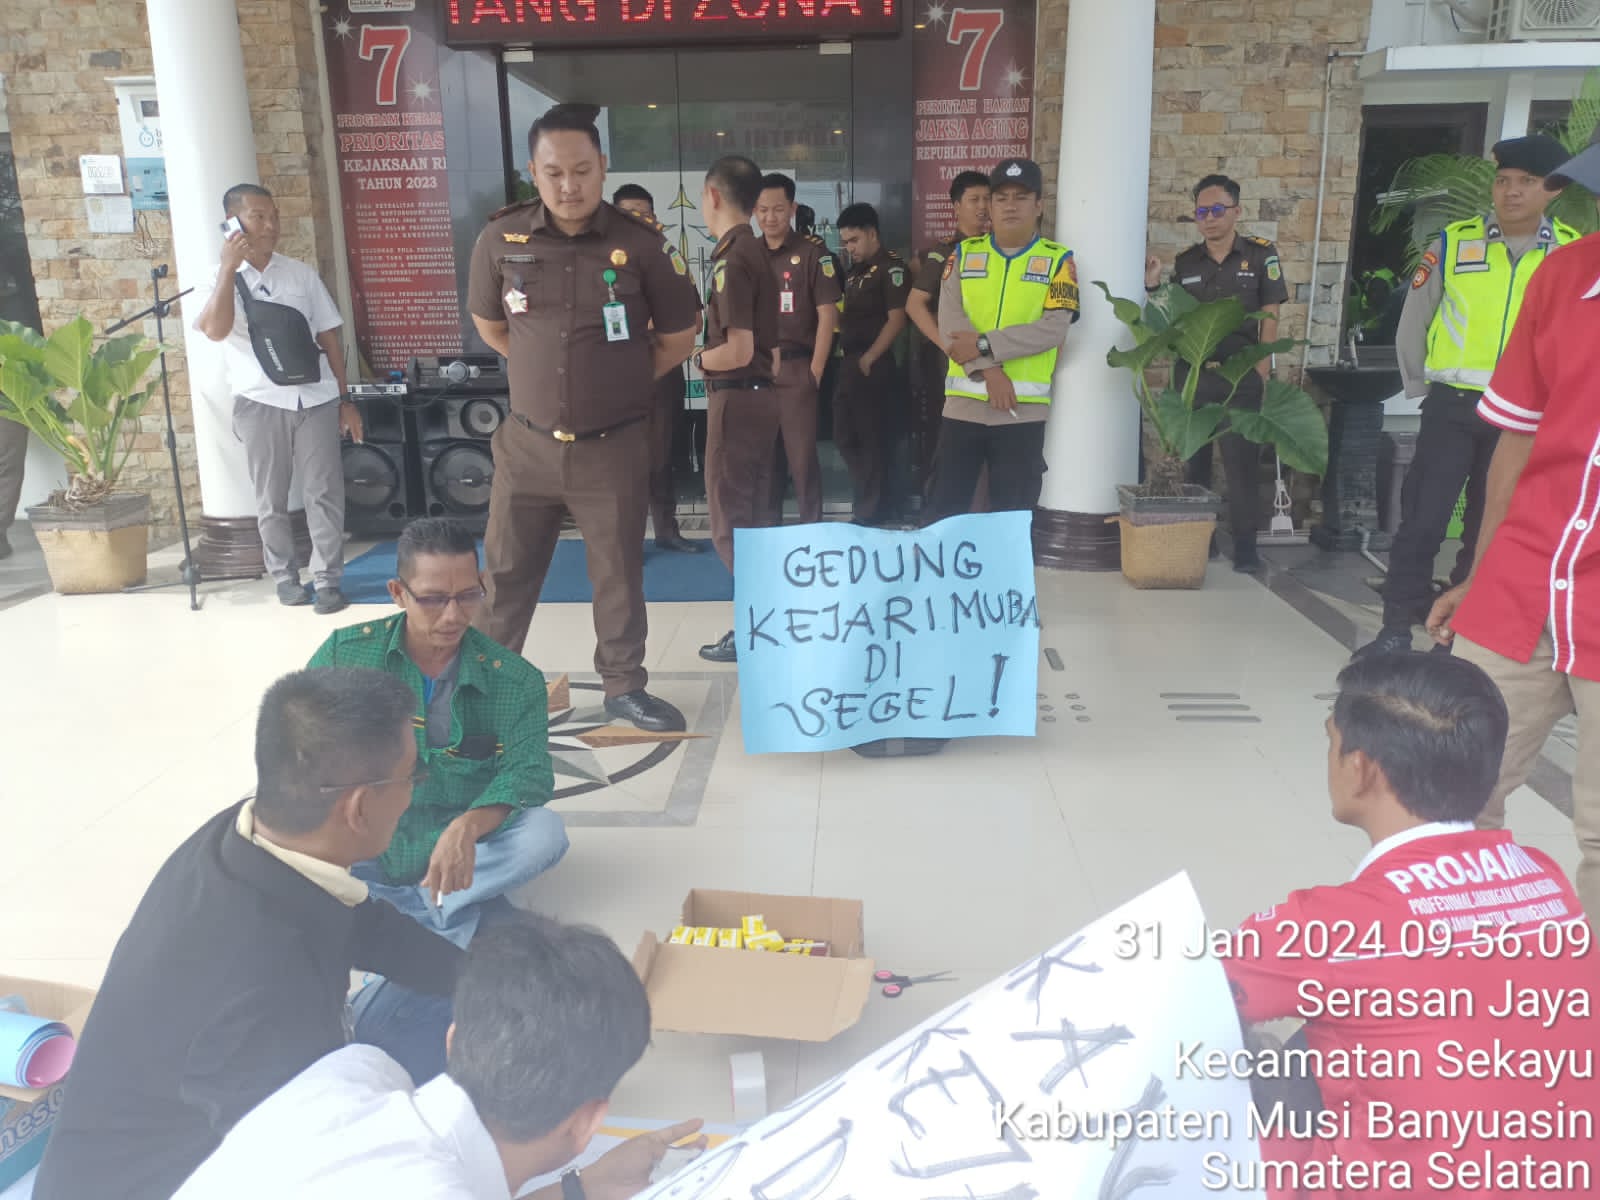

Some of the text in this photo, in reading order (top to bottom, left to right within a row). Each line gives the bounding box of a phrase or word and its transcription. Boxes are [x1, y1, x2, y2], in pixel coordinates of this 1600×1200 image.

[947, 8, 1004, 91] 7
[358, 24, 411, 105] 7
[916, 98, 1030, 115] PERINTAH HARIAN
[337, 113, 400, 127] PROGRAM
[916, 117, 1029, 141] JAKSA AGUNG
[338, 131, 445, 152] PRIORITAS
[916, 144, 1027, 160] REPUBLIK INDONESIA
[343, 157, 447, 172] KEJAKSAAN RI
[358, 176, 437, 190] TAHUN 2023
[783, 541, 983, 587] GEDUNG
[950, 589, 1041, 632] MUBA
[864, 641, 902, 684] DI
